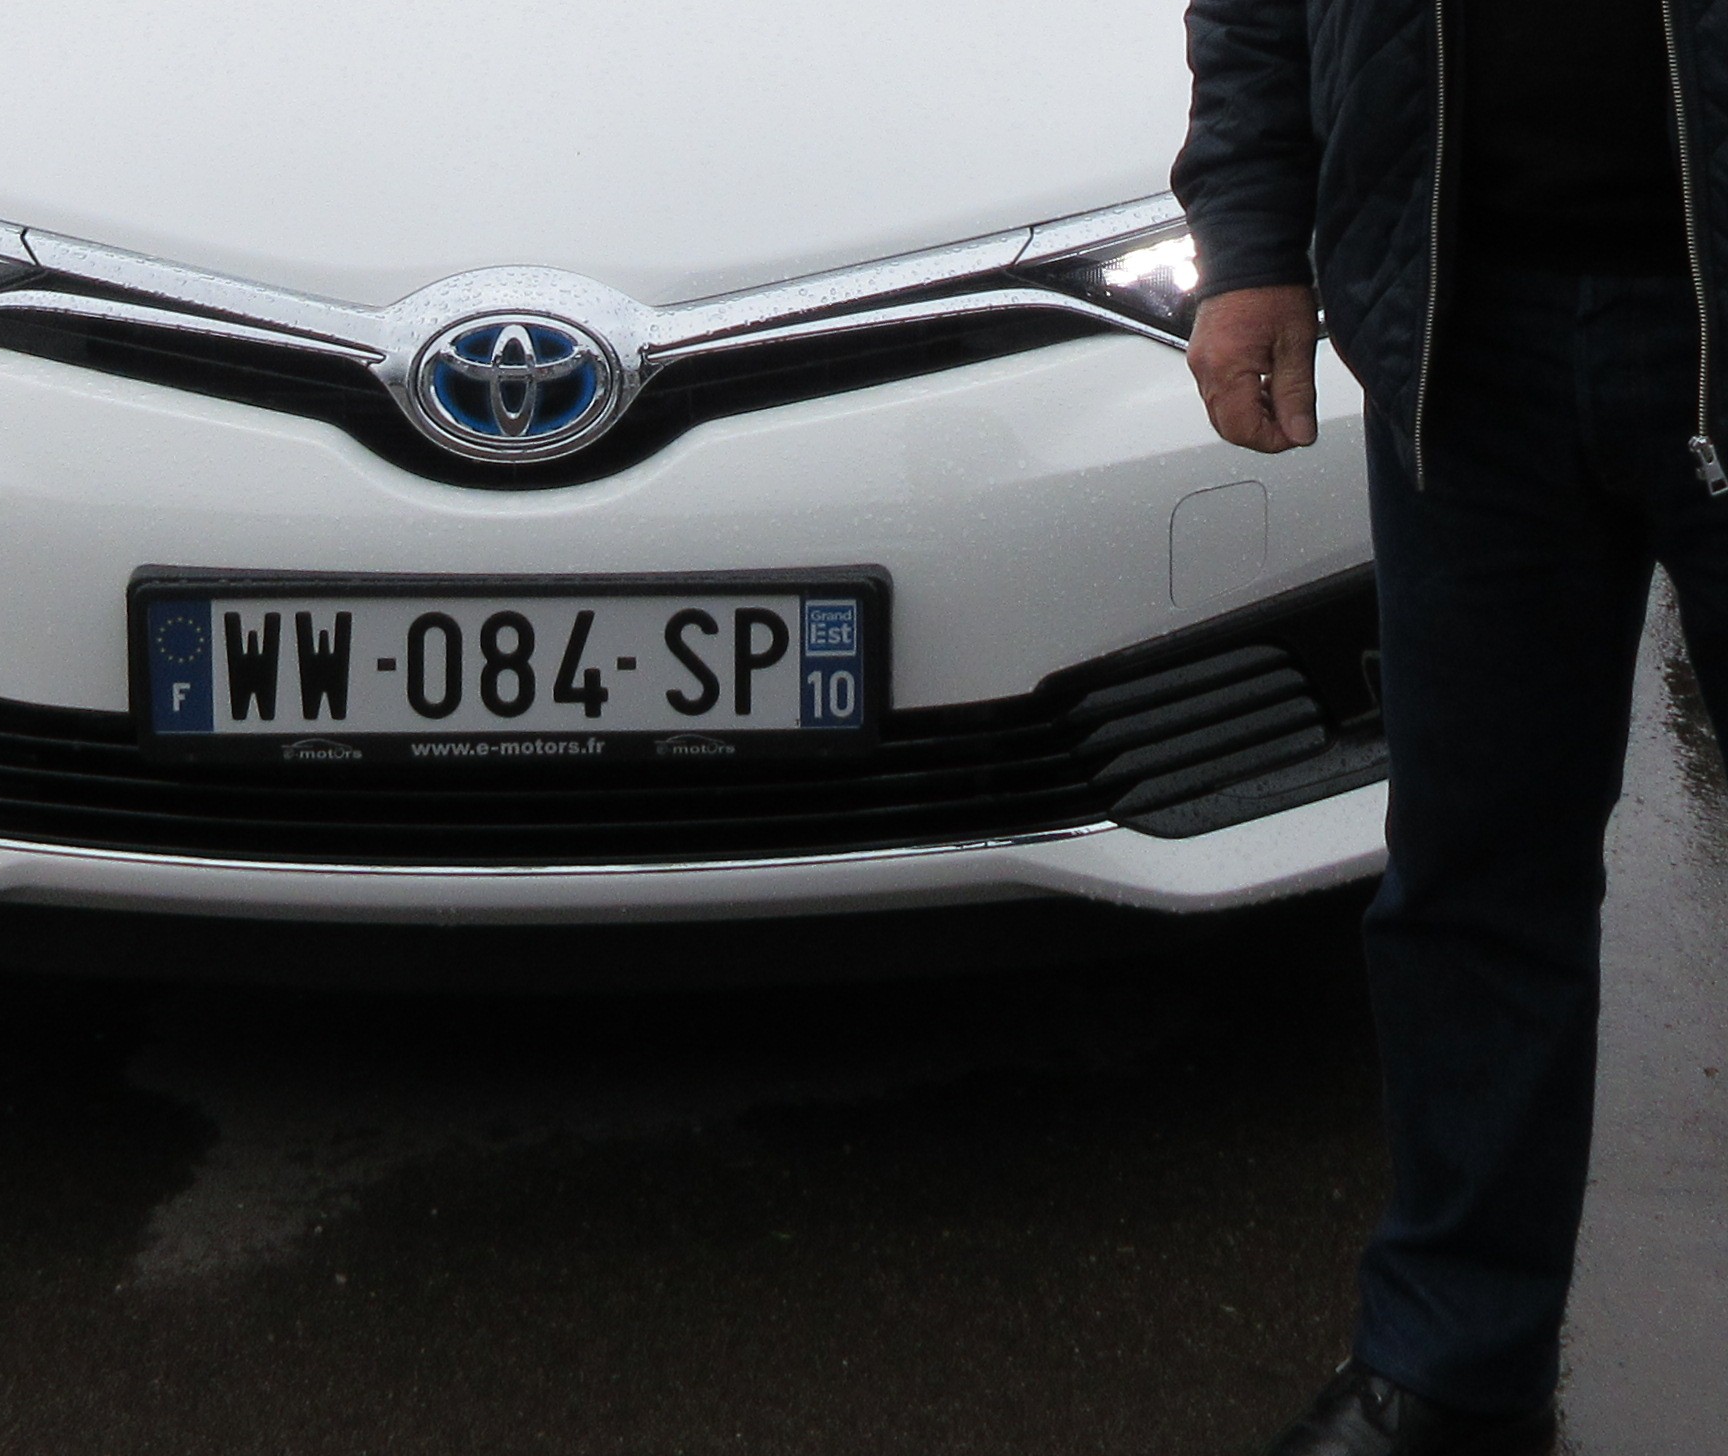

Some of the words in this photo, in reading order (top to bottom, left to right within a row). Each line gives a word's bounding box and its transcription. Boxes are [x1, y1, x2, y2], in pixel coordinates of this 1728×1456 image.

[811, 609, 853, 622] Grand
[811, 623, 853, 644] Est
[172, 682, 191, 712] F
[807, 670, 855, 718] 10
[411, 737, 606, 757] www.e-motors.fr
